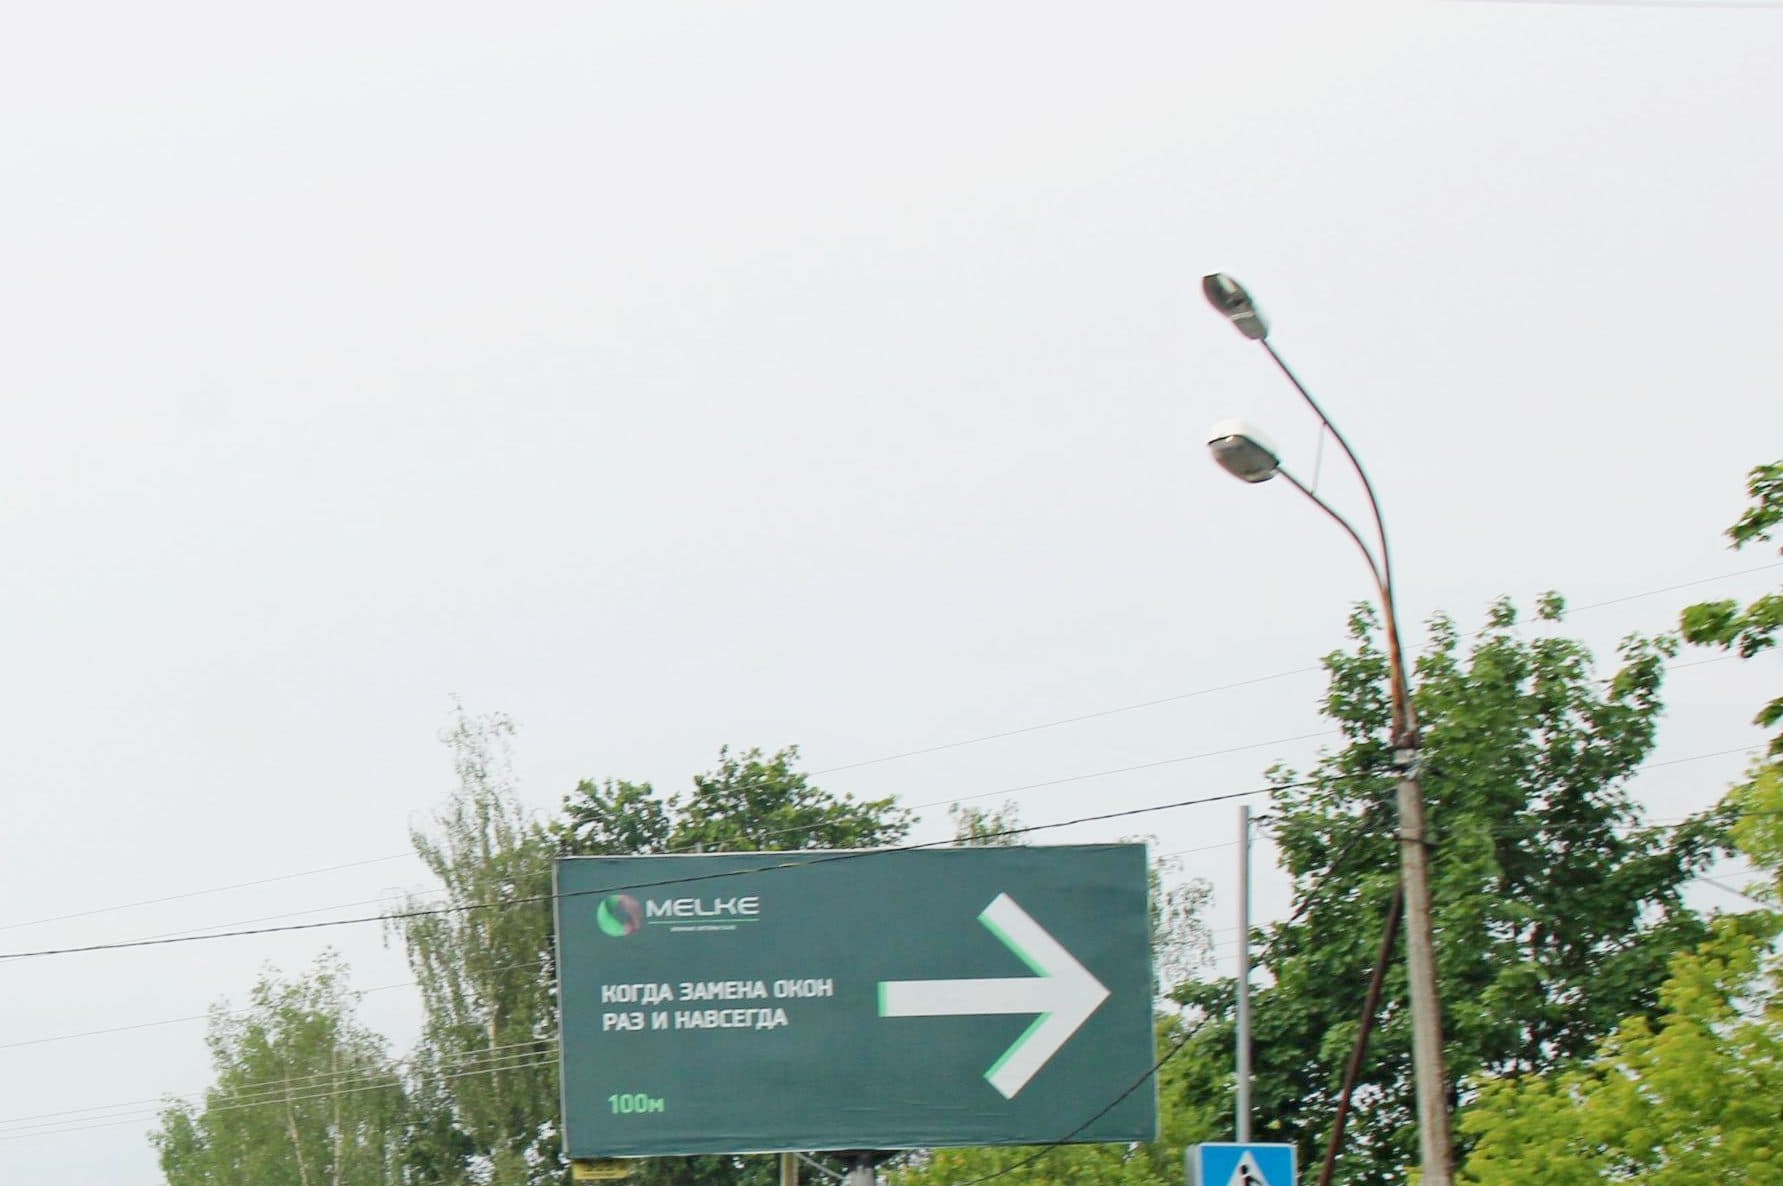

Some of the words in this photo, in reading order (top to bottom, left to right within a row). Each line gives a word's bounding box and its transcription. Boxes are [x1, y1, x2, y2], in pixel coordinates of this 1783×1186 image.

[646, 897, 760, 917] MELKE
[601, 982, 674, 1005] КОГДА
[679, 980, 768, 1001] ЗАМЕНА
[773, 978, 833, 999] ОКОН
[602, 1012, 645, 1031] РАЗ
[651, 1011, 668, 1030] И
[674, 1008, 789, 1030] НАВСЕГДА
[607, 1093, 665, 1114] 100м
